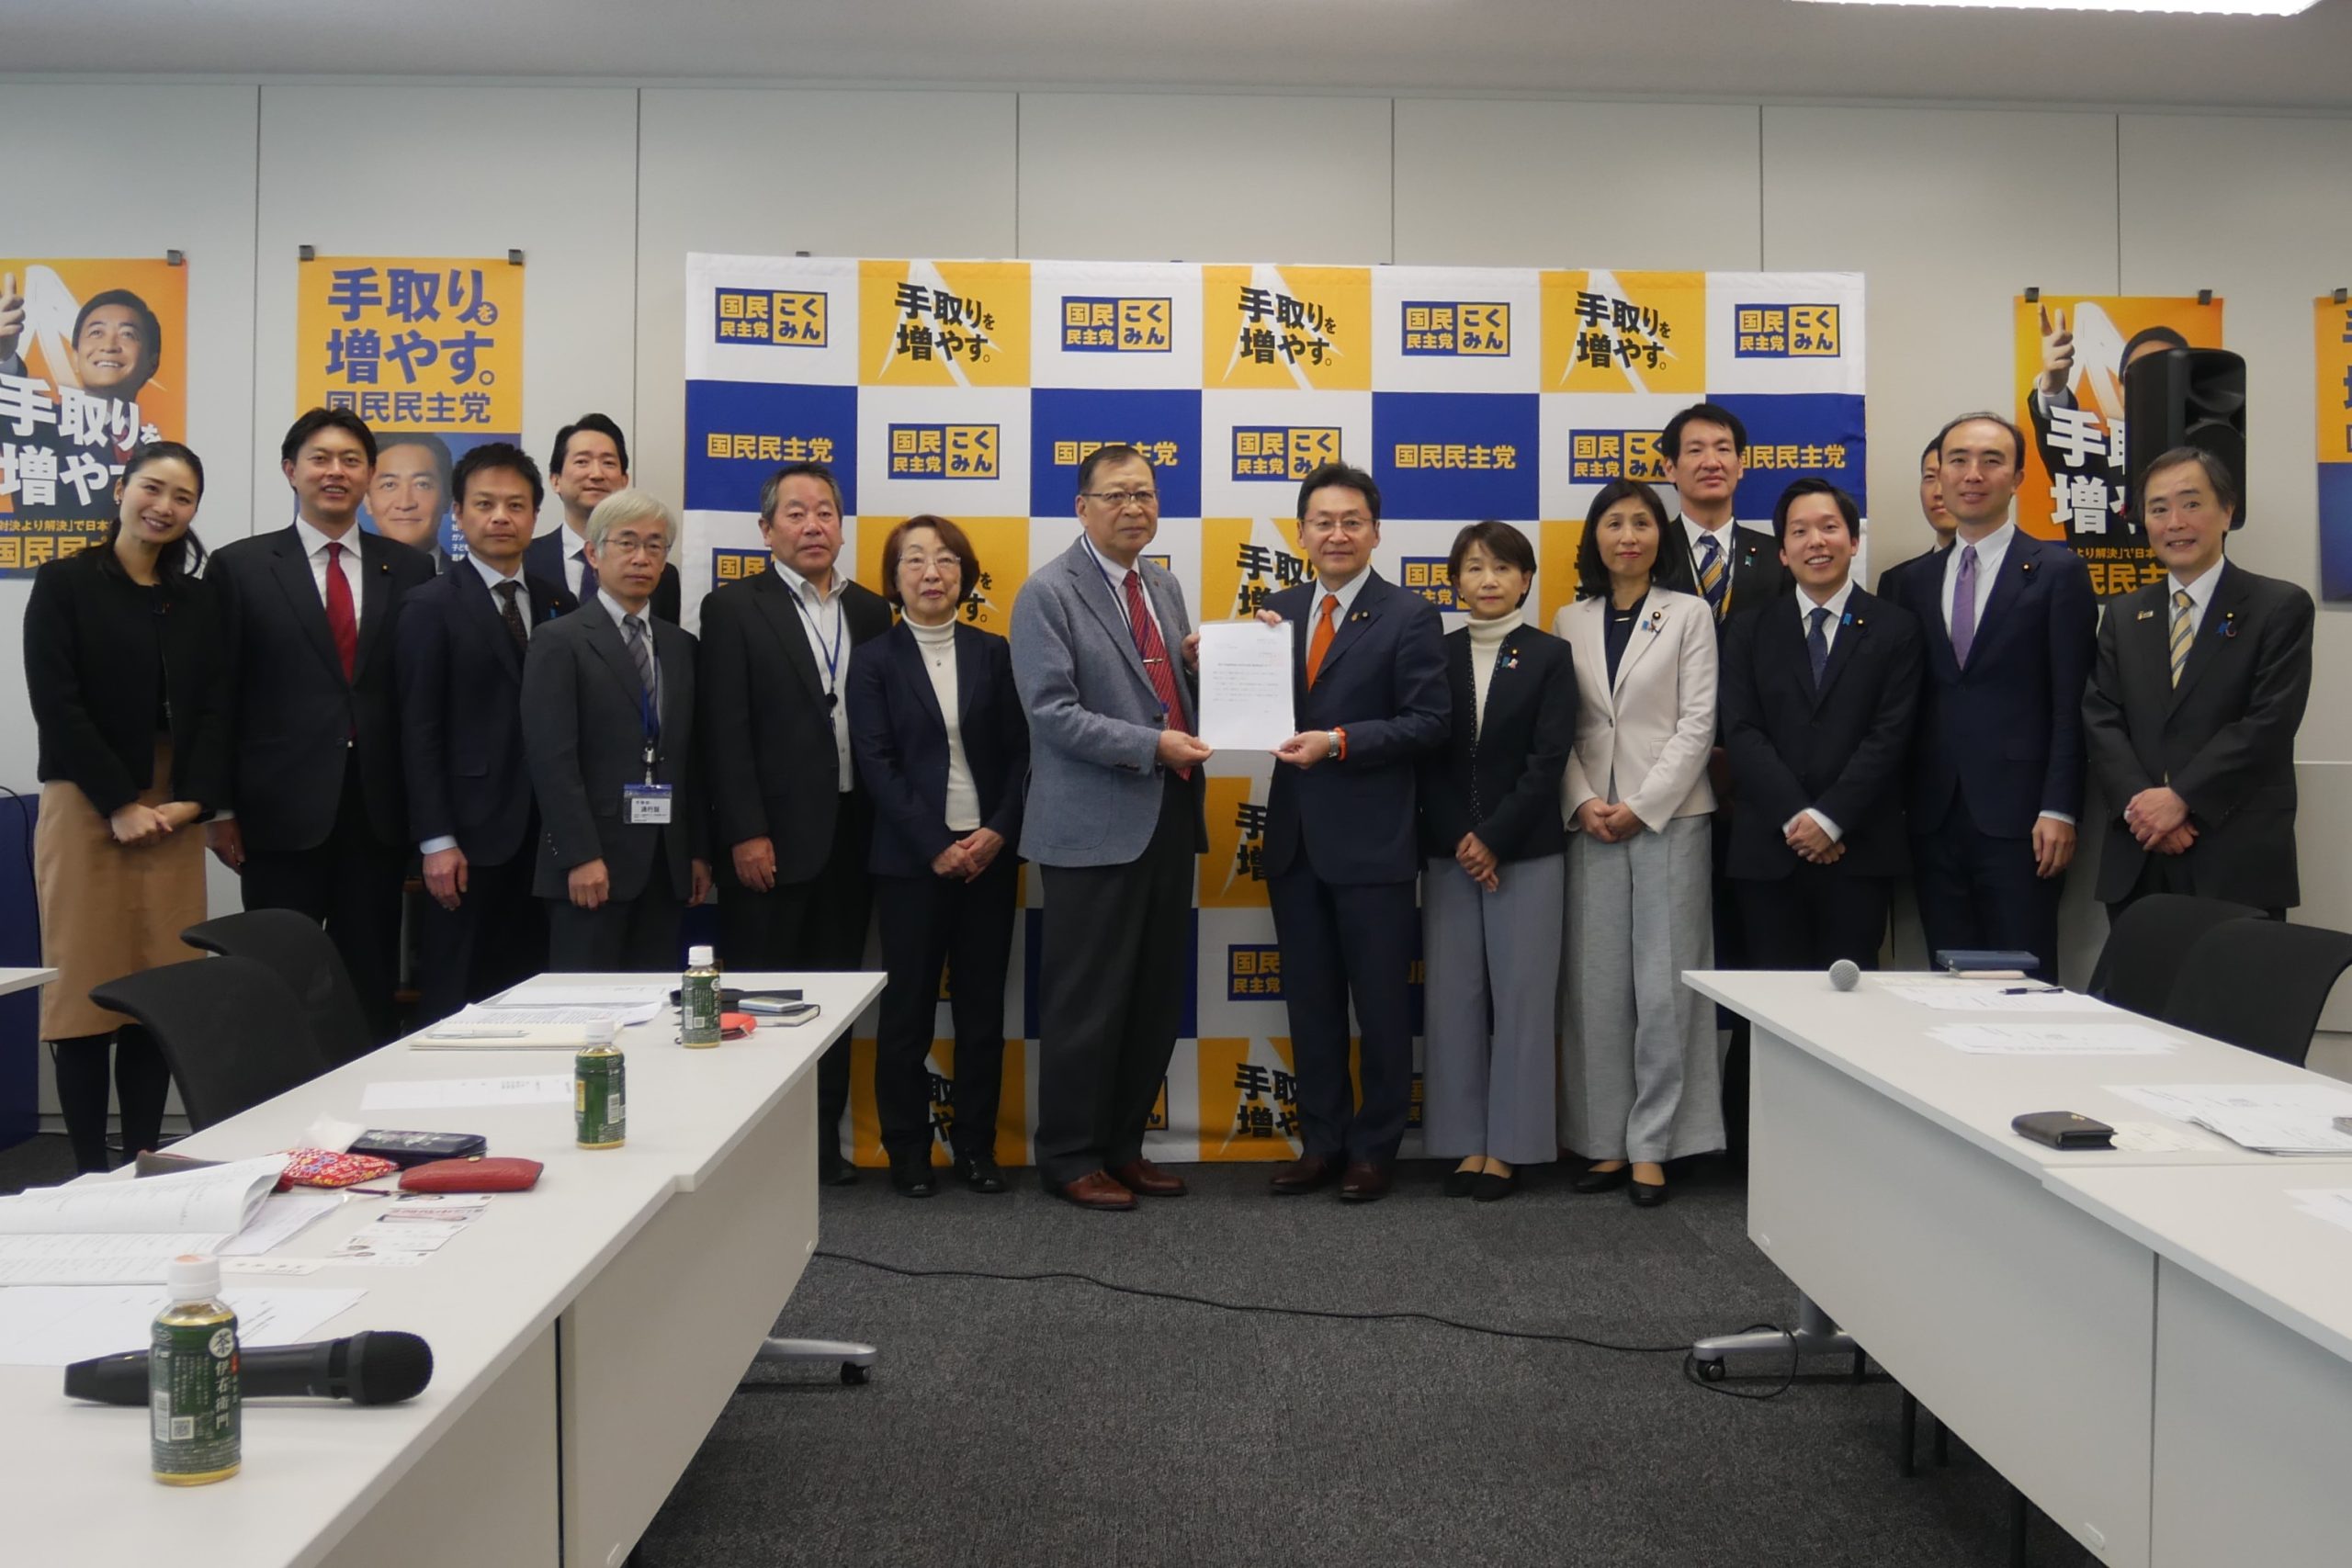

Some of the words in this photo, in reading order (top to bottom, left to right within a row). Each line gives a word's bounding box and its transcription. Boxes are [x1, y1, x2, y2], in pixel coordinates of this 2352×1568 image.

[328, 267, 498, 325] 手取りを
[895, 281, 994, 331] 手取りを
[719, 294, 769, 320] 国民
[780, 297, 818, 317] こく
[1066, 302, 1114, 327] 国民
[1125, 303, 1162, 322] こく
[1238, 286, 1336, 334] 手取りを
[1575, 290, 1670, 339] 手取りを
[1406, 307, 1453, 331] 国民
[1463, 308, 1500, 328] こく
[1739, 310, 1784, 333] 国民
[1795, 310, 1830, 329] こく
[719, 321, 769, 339] 民主党
[778, 321, 820, 340] みん
[1066, 329, 1114, 345] 民主党
[1124, 326, 1165, 345] みん
[1463, 331, 1503, 350] みん
[896, 323, 990, 363] 増やす。
[1240, 327, 1332, 367] 増やす。
[1406, 332, 1453, 350] 民主党
[1577, 332, 1667, 370] 増やす。
[1739, 334, 1784, 352] 民主党
[1793, 333, 1833, 350] みん
[325, 328, 495, 386] 増やす。
[707, 433, 833, 463] 国民民主党
[892, 430, 942, 453] 国民
[952, 430, 989, 450] こく
[1236, 432, 1284, 456] 国民
[1295, 432, 1331, 453] こく
[1574, 435, 1620, 458] 国民
[892, 457, 942, 473] 民主党
[950, 454, 992, 472] みん
[1236, 457, 1284, 475] 民主党
[1395, 444, 1516, 469] 国民民主党
[0, 442, 125, 506] 増や
[1574, 461, 1620, 478] 民主党
[0, 519, 111, 532] 対決より解決」で日本
[0, 536, 107, 569] 国民民
[1411, 589, 1453, 605] 主党
[1233, 951, 1280, 975] 国民
[1233, 976, 1281, 994] 民主党
